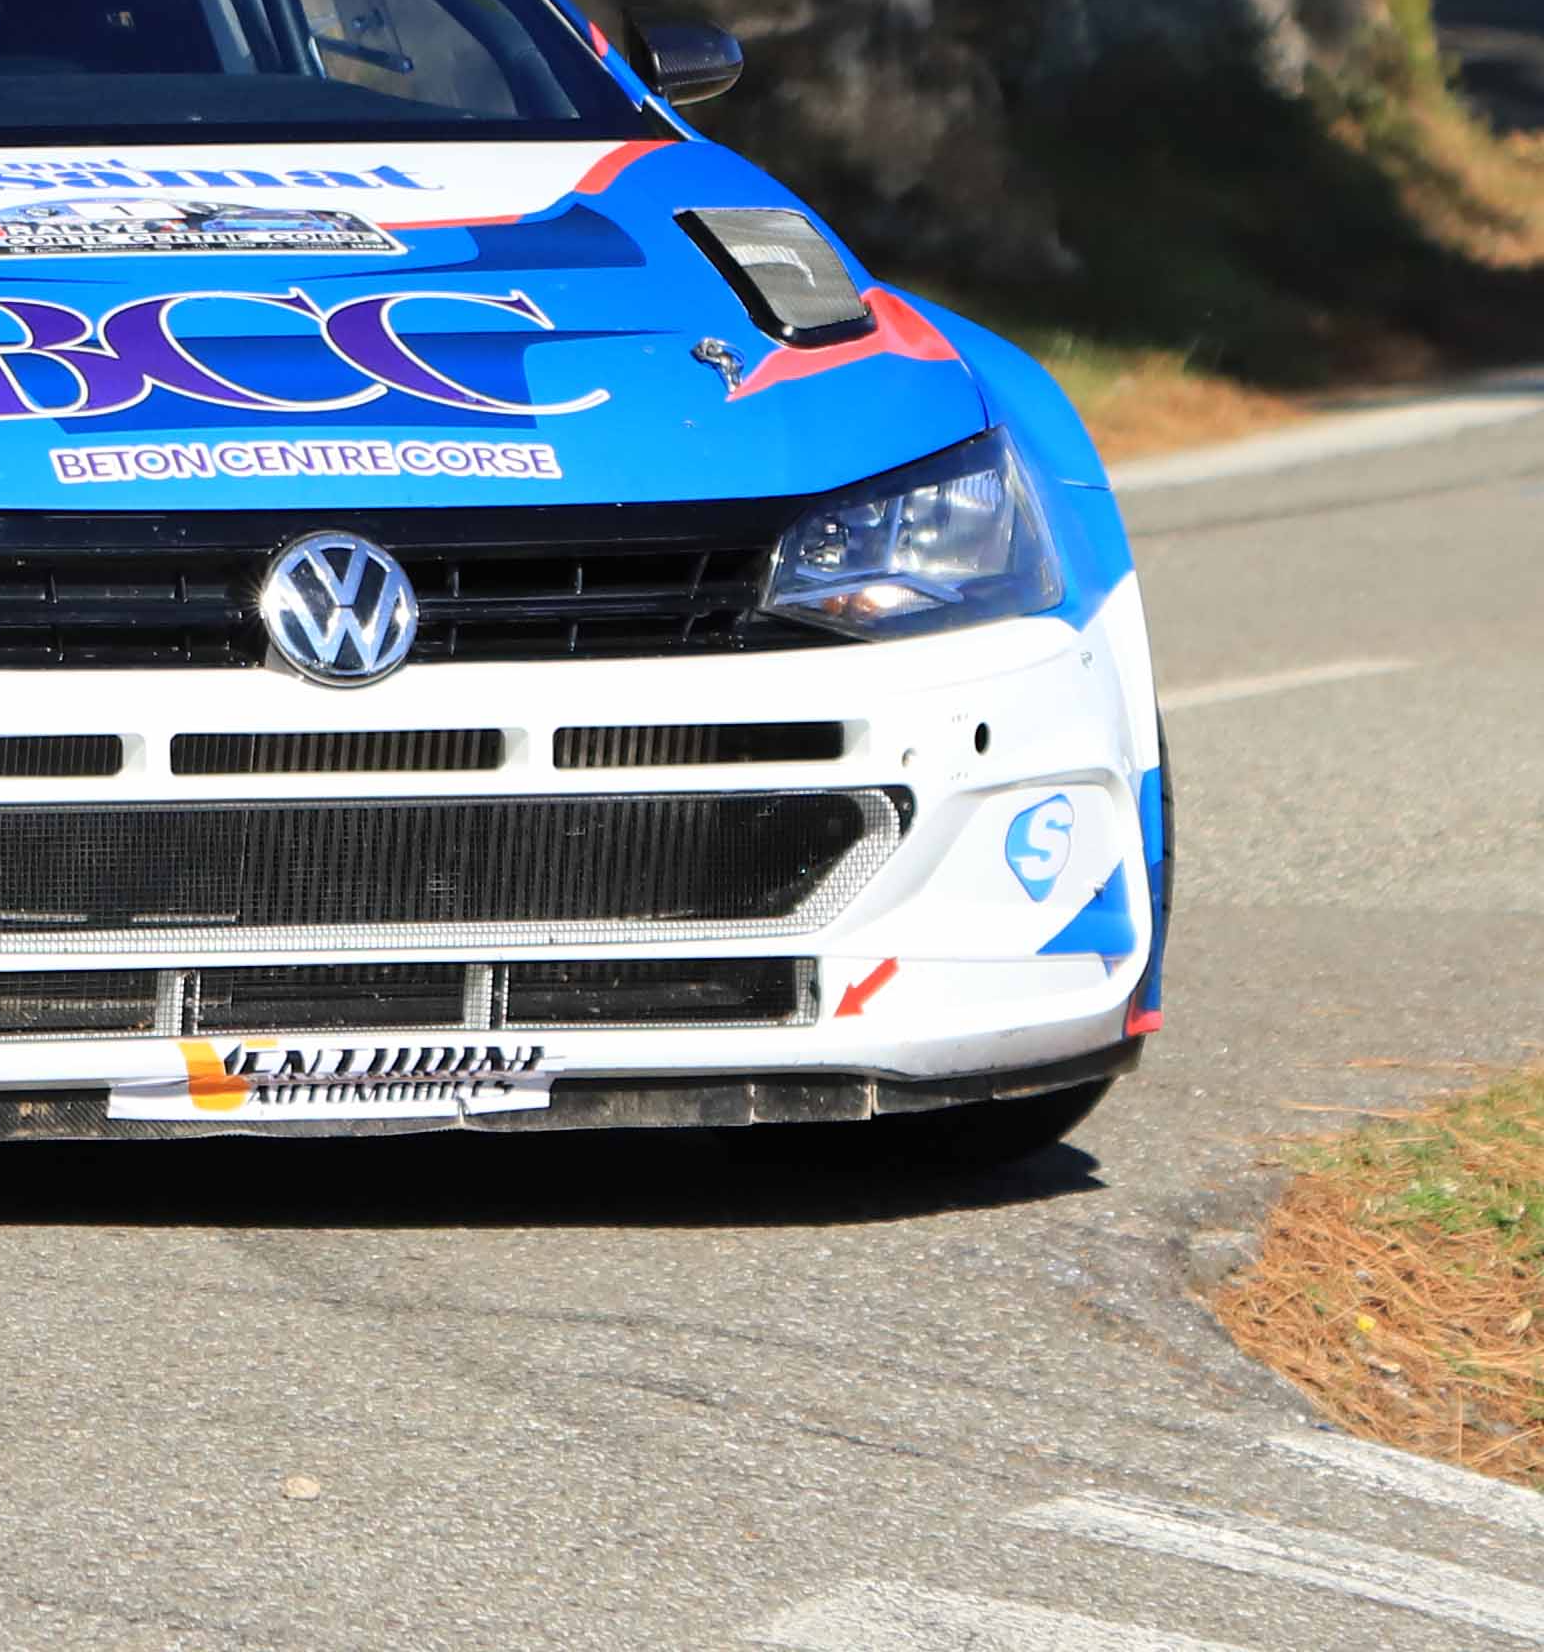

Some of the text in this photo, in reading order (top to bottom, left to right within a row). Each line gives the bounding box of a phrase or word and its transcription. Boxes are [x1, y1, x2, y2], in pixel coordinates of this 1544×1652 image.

[7, 222, 149, 236] RALLYE
[5, 232, 373, 246] CORTE CENTRE CORSE
[60, 443, 556, 480] BETON CENTRE CORSE
